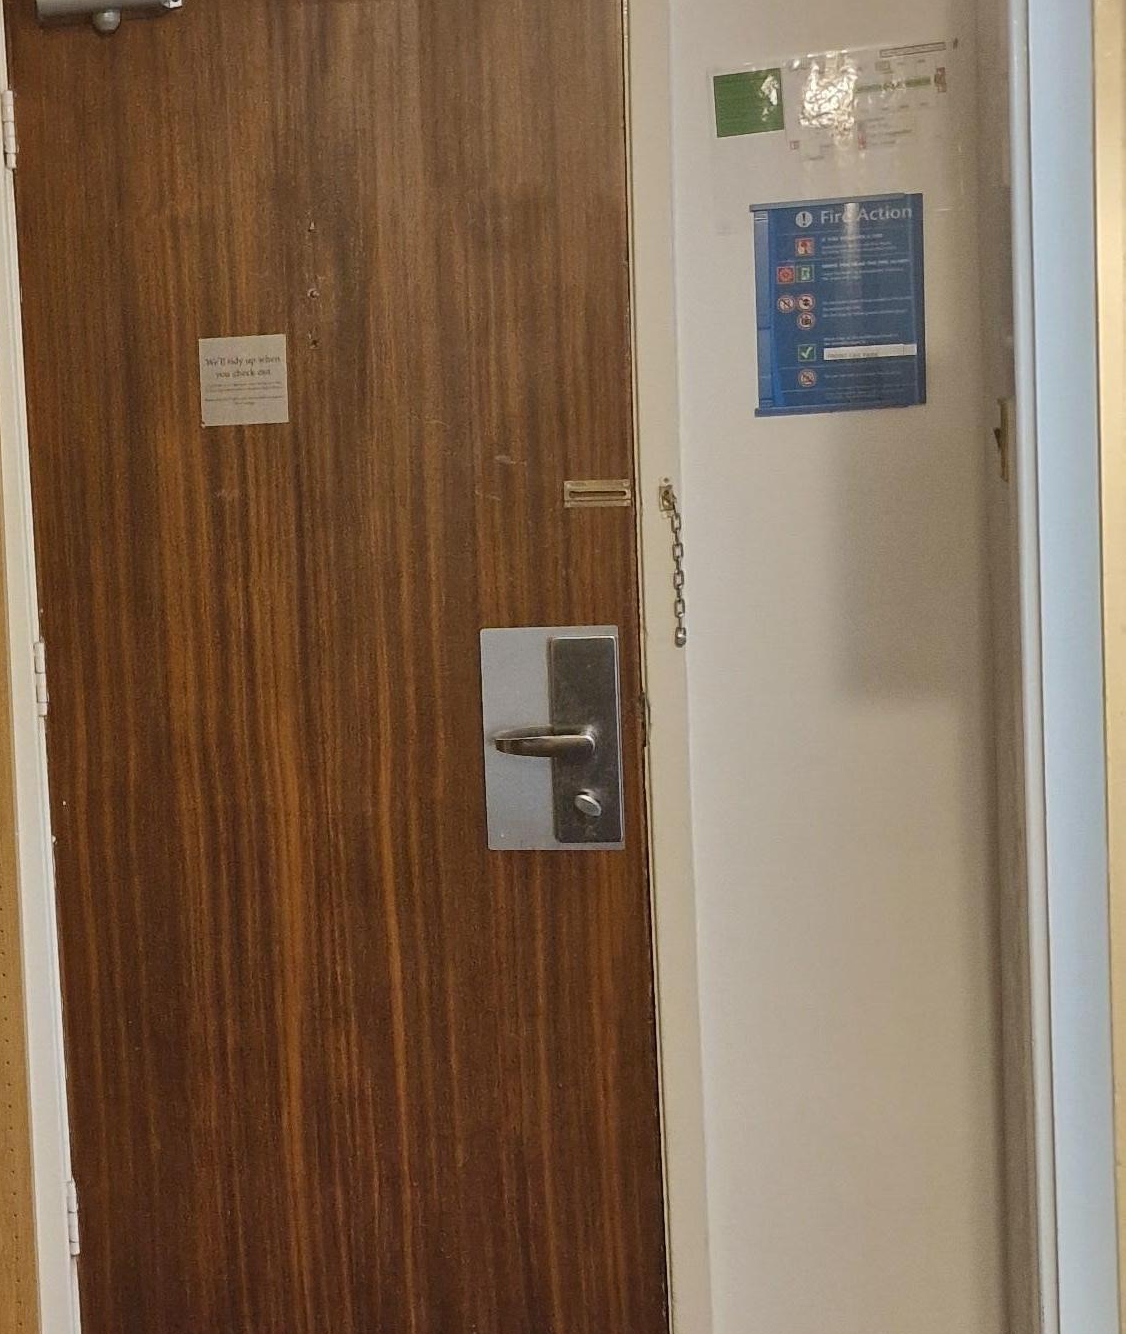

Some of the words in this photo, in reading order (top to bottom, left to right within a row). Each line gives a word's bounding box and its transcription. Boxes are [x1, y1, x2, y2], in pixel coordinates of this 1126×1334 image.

[820, 209, 853, 224] Fire
[857, 205, 913, 222] Action
[245, 357, 256, 366] up
[258, 354, 281, 364] when
[232, 368, 254, 377] check
